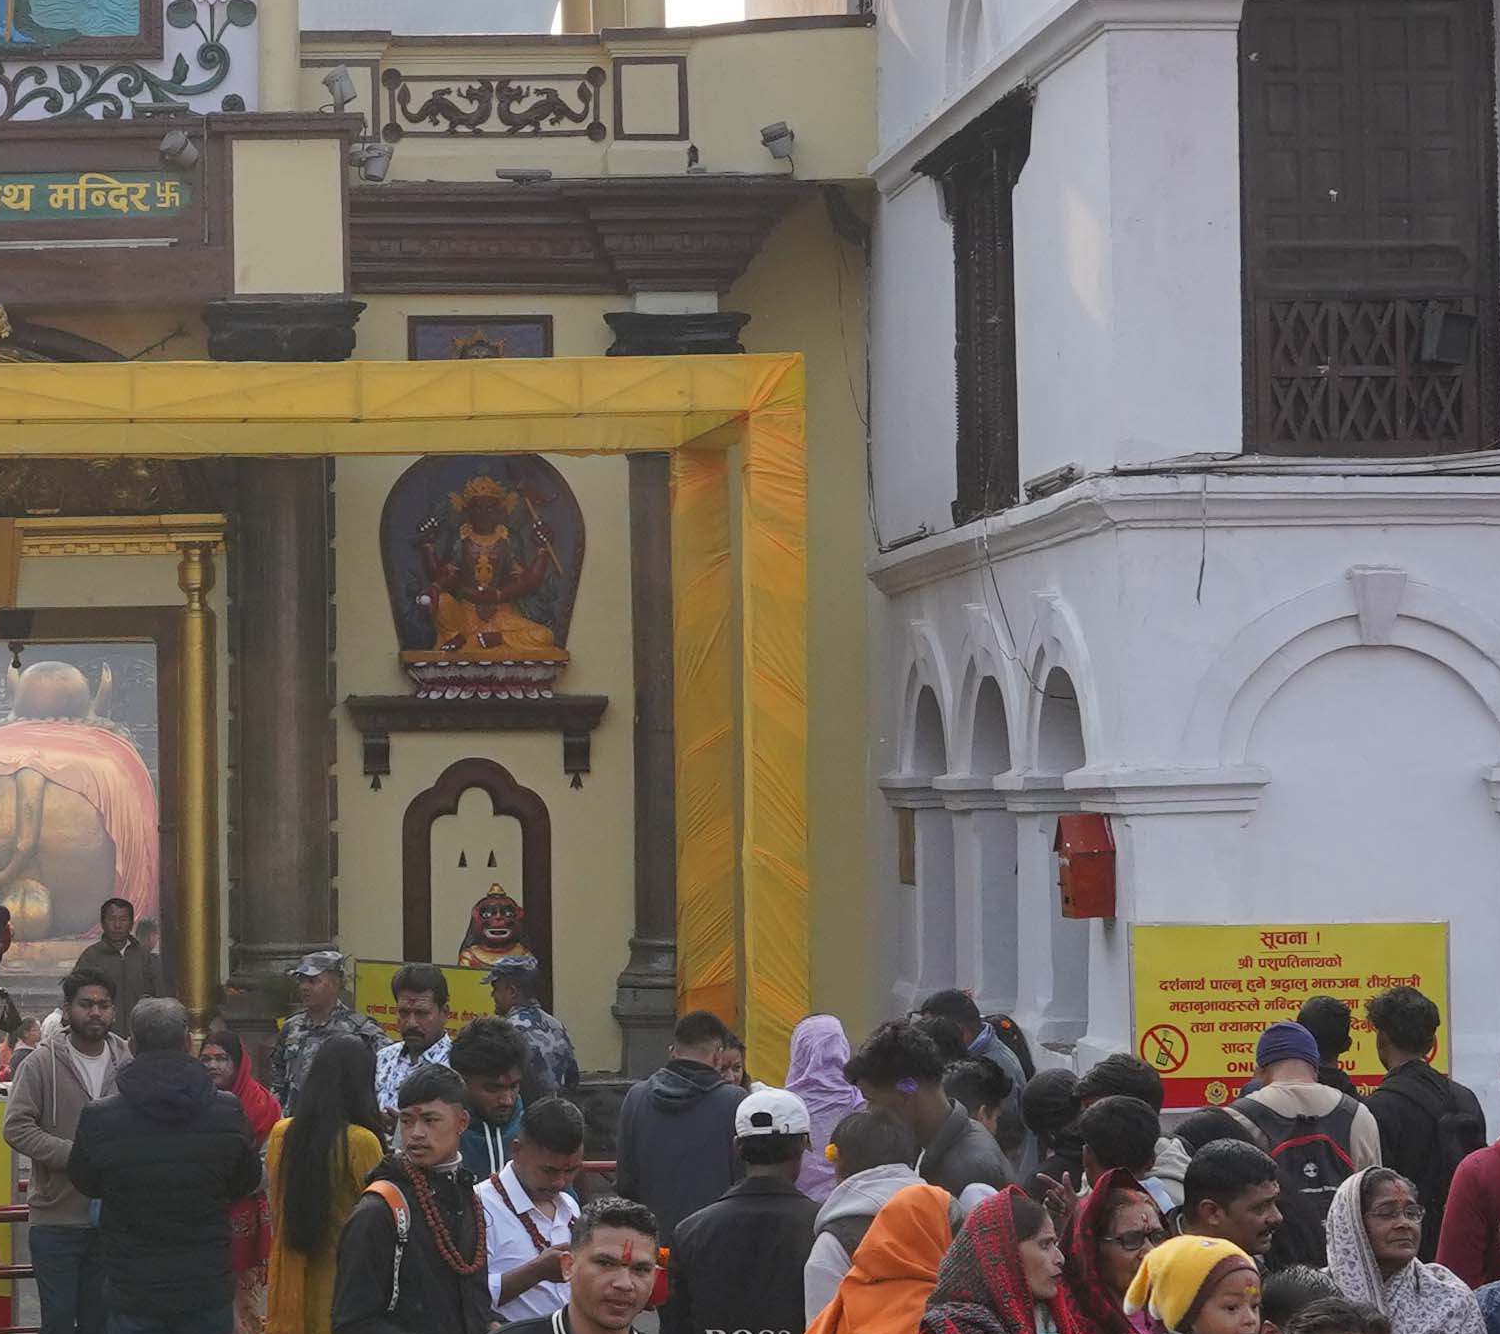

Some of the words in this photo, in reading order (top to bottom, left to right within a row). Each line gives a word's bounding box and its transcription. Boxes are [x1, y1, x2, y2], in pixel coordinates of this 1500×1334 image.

[48, 173, 151, 213] मन्दिर
[1260, 931, 1308, 949] सूचना
[1237, 954, 1253, 970] श्री
[1258, 954, 1342, 971] पशुपतिनाथको
[1159, 976, 1206, 992] दर्शनार्थ
[1210, 979, 1243, 993] पाल्नु
[1246, 976, 1266, 993] हुने
[1367, 973, 1421, 988] तीर्थयात्री
[1190, 1021, 1215, 1034] तथा
[1221, 1041, 1255, 1055] सादर
